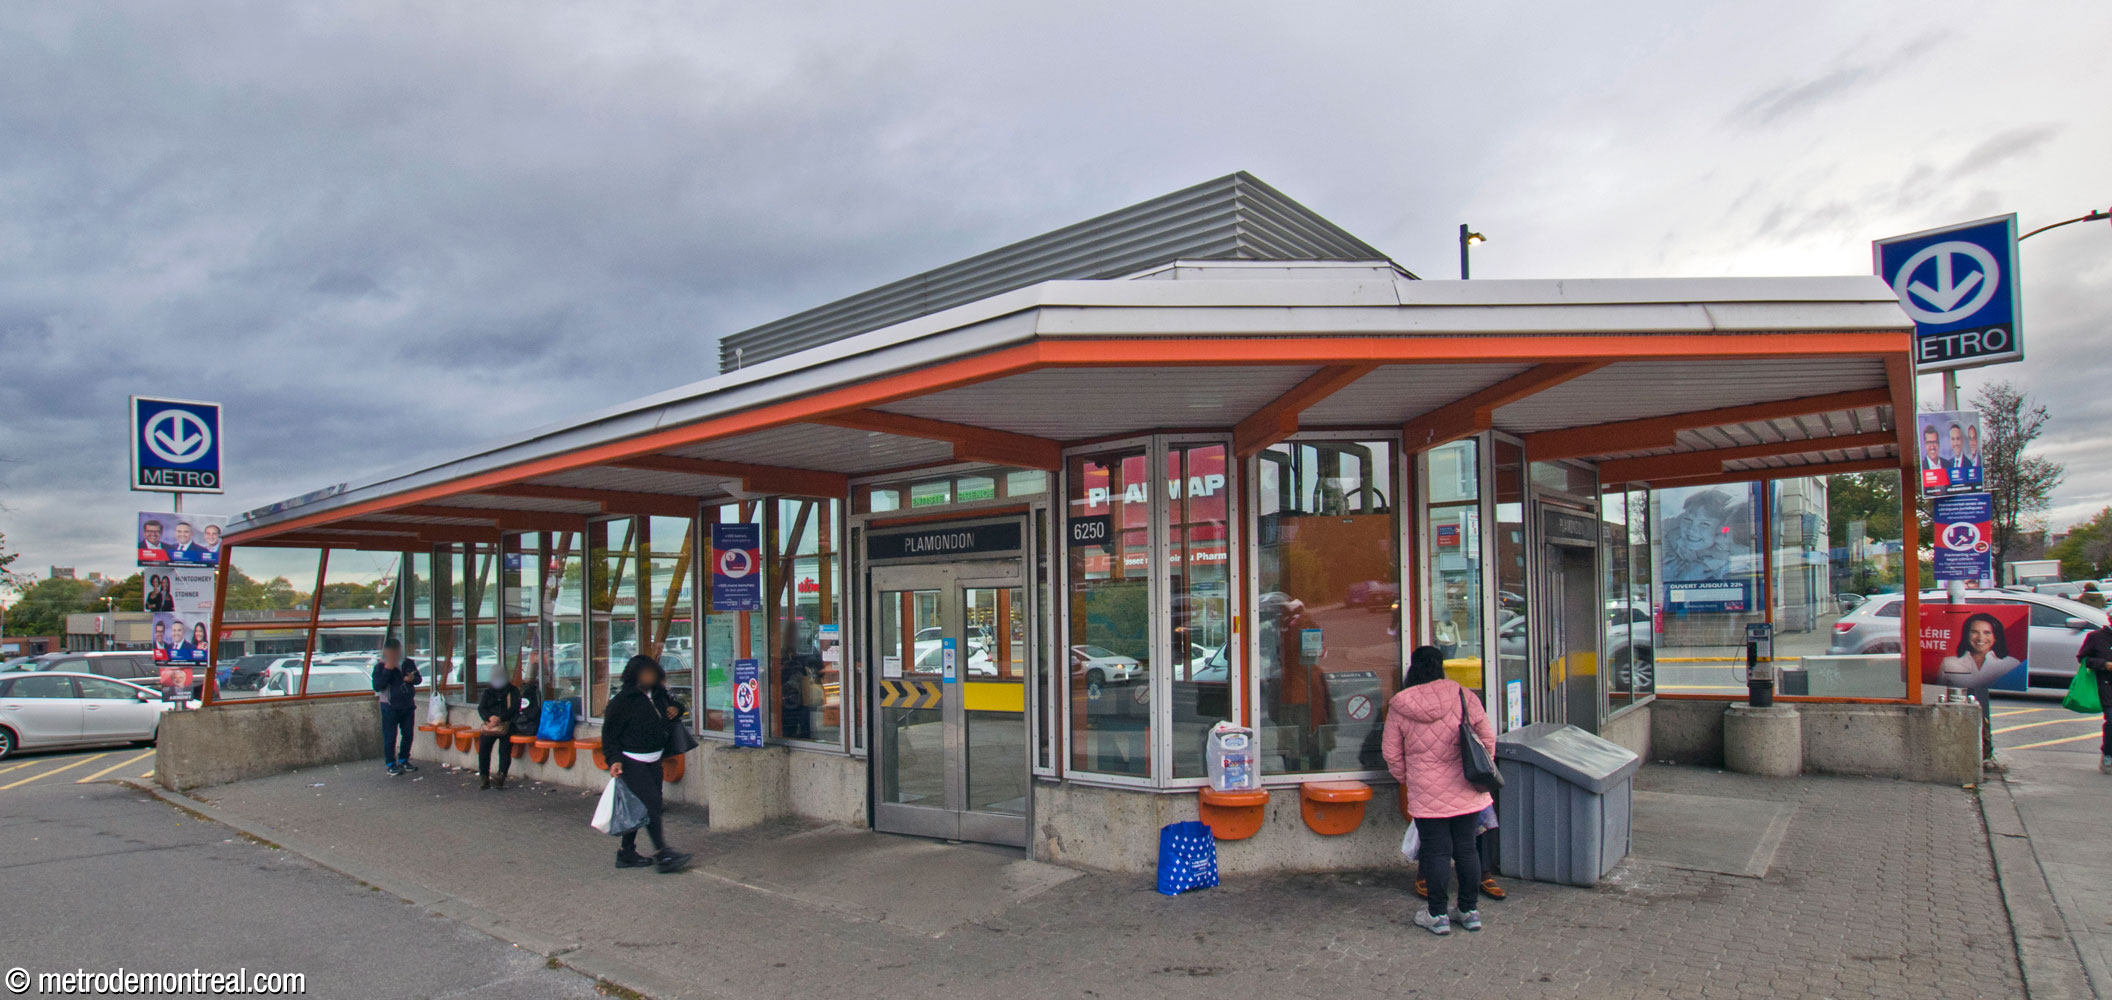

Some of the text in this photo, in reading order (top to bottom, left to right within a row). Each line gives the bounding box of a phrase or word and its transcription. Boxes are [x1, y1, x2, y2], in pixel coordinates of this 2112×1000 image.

[1917, 327, 2008, 361] ETRO
[143, 468, 216, 487] METRO
[1074, 521, 1105, 540] 6250
[904, 532, 975, 553] PLAMONDON
[1920, 626, 1951, 639] LÉRIE
[1920, 640, 1947, 650] ANTE
